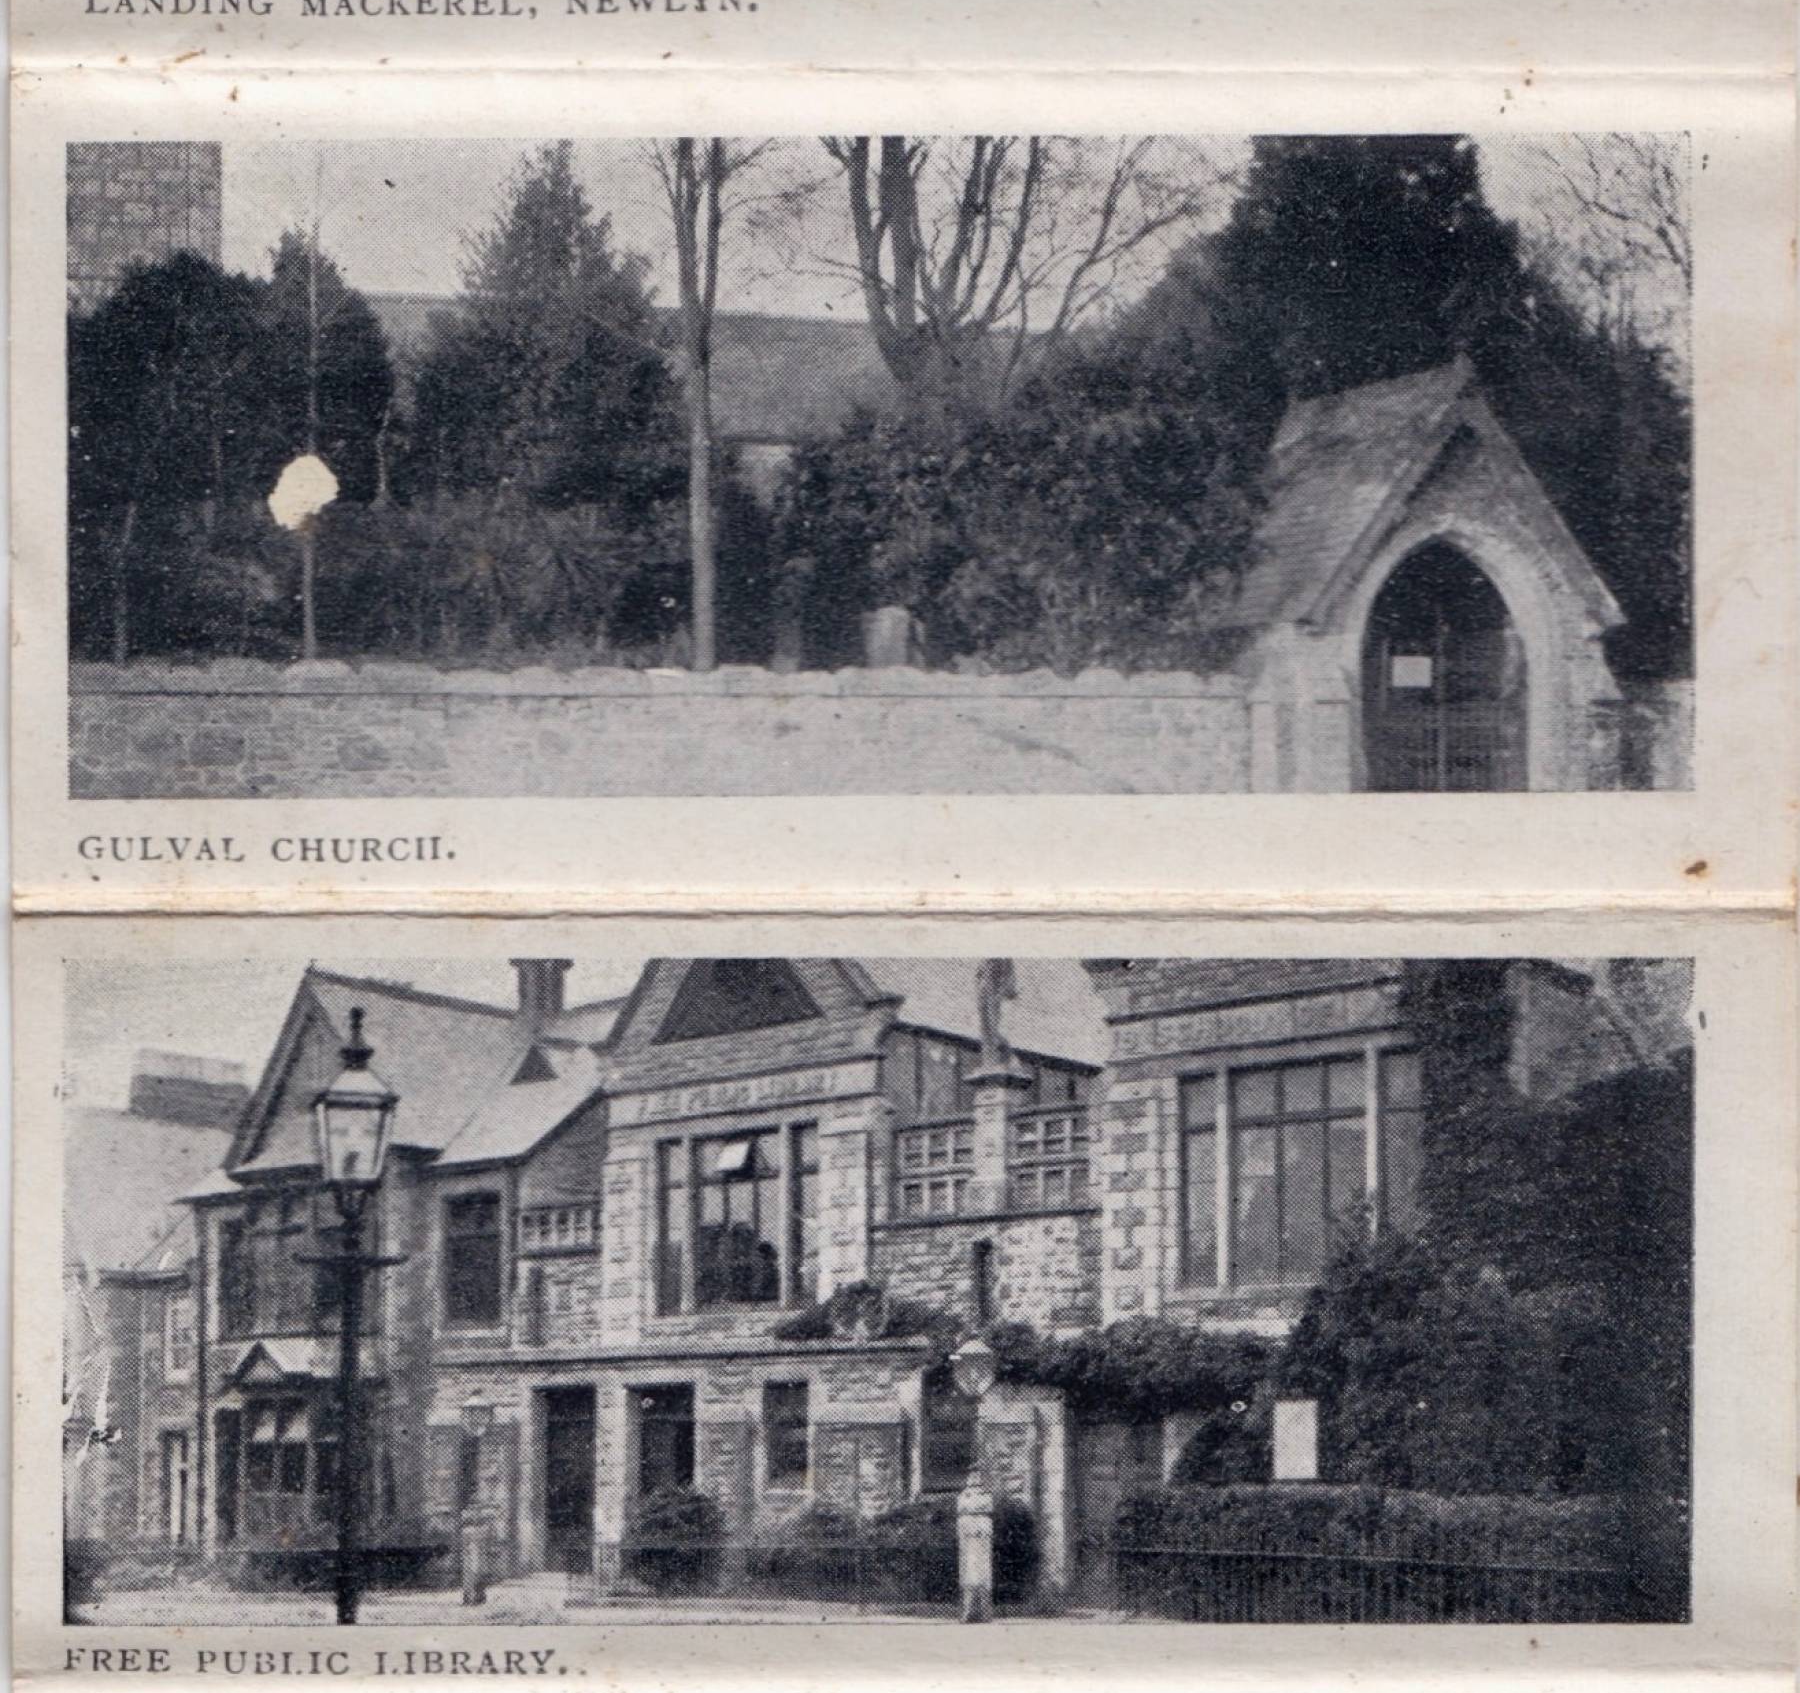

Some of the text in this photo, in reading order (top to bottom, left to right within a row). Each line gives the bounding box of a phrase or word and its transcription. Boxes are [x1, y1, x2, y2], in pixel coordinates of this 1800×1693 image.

[77, 835, 457, 864] GULVAL CHURCH.
[63, 1647, 171, 1673] FREE
[197, 1650, 350, 1676] PUBLIC
